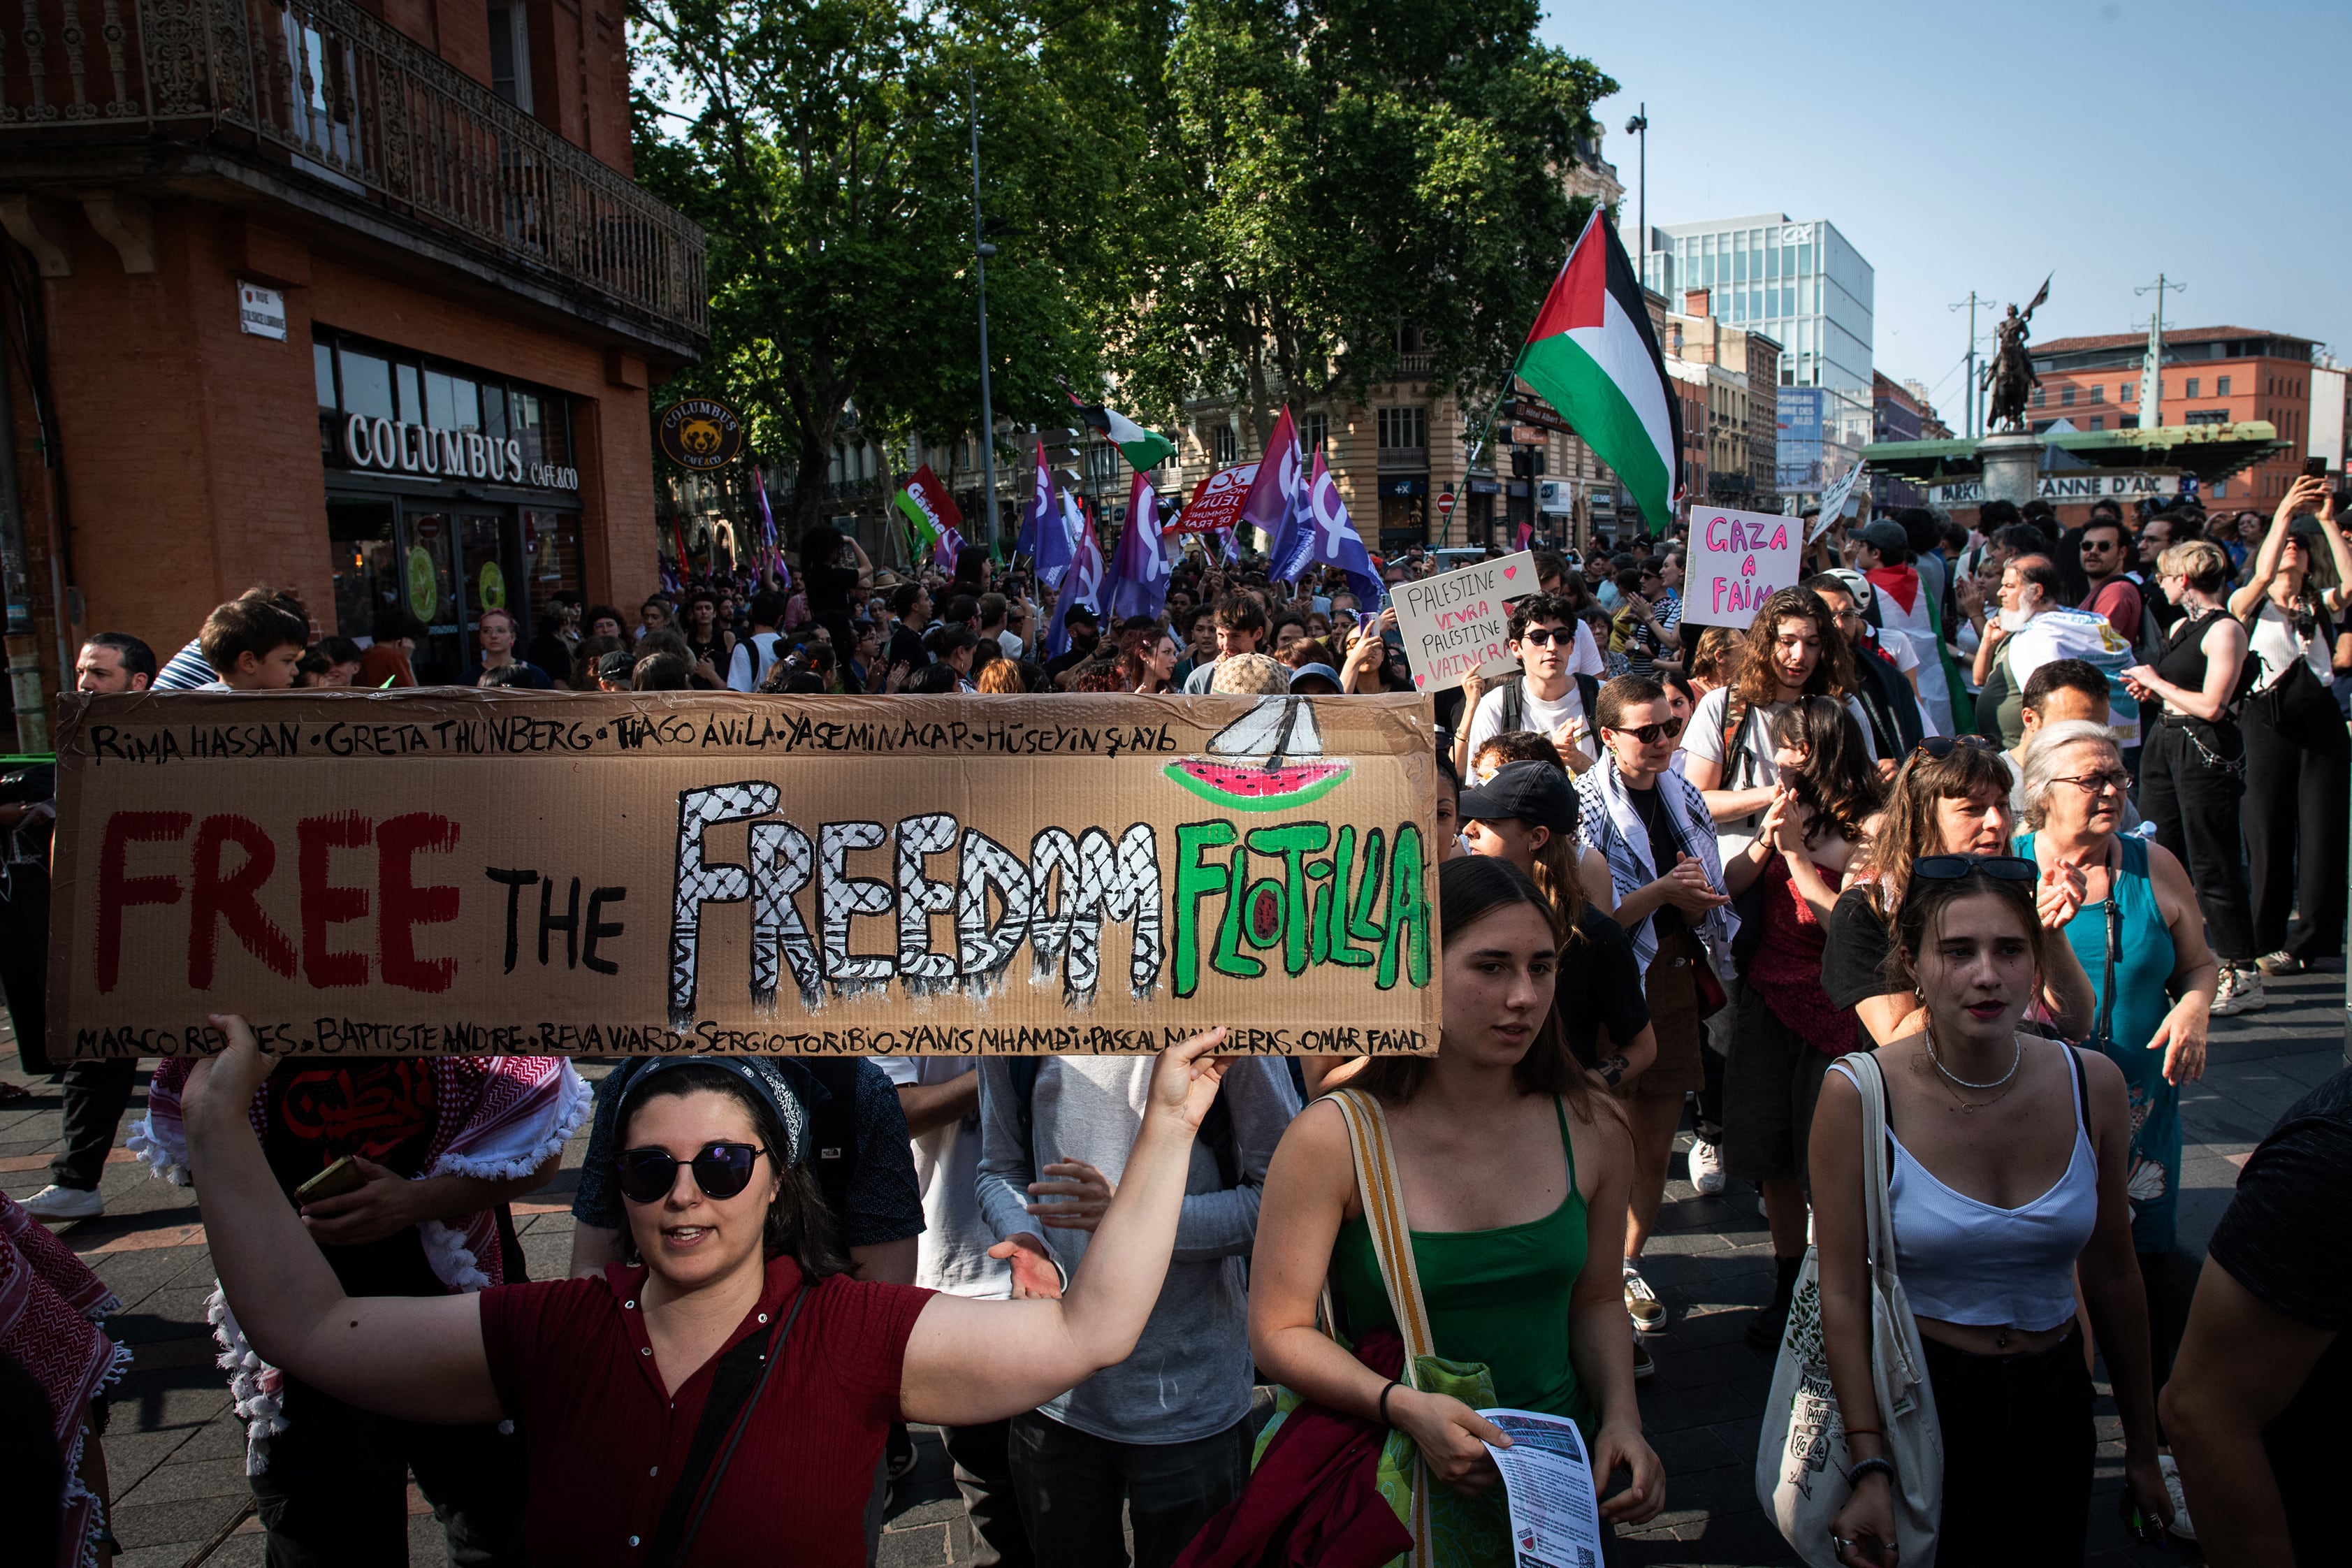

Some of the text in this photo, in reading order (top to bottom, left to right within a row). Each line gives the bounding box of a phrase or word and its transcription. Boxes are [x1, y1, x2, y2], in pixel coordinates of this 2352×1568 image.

[665, 402, 736, 431] COLUMBUS
[348, 414, 522, 482] COLUMBUS
[2113, 477, 2161, 493] D'ARC
[2189, 480, 2198, 490] P
[1706, 516, 1787, 553] GAZA
[1741, 554, 1756, 576] A
[1407, 570, 1495, 617] PALESTINE
[1435, 600, 1489, 631] VIVRA
[1423, 620, 1500, 658] PALESTINE
[191, 722, 299, 759] HASSAN
[325, 721, 428, 756] GRETA
[432, 716, 593, 754] THUNBERG
[899, 720, 974, 750] ACAR
[94, 808, 460, 994] FREE
[486, 866, 627, 975] THE
[668, 780, 1165, 1020] FREEDOM
[75, 1024, 178, 1057] MARCO
[185, 1022, 298, 1057] REES
[537, 1022, 604, 1054] REVA
[1090, 1025, 1164, 1052] PASCAL
[1300, 1026, 1370, 1055] OMAR
[1807, 1407, 1830, 1428] POUR
[1531, 1437, 1576, 1452] PALESTINIEN
